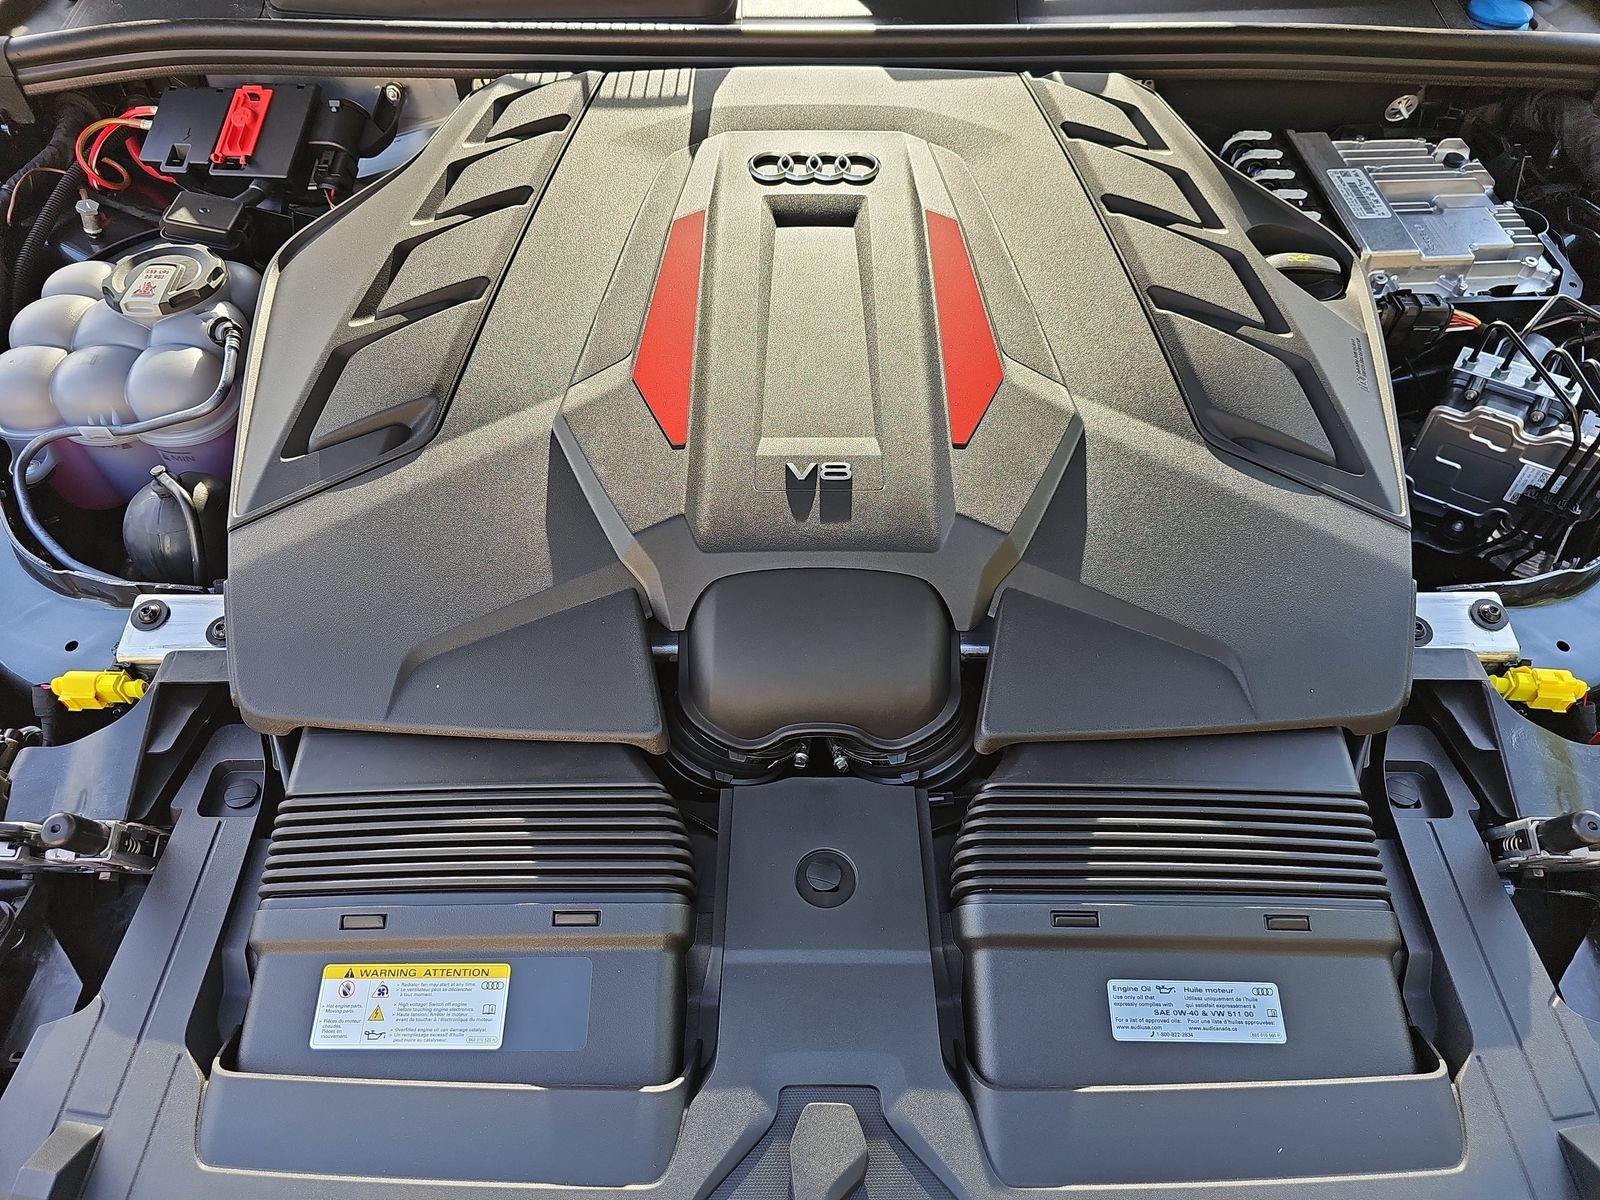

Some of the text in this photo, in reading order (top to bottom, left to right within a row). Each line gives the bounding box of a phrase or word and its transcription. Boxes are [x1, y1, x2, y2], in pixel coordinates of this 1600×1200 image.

[786, 462, 852, 480] V8
[360, 968, 490, 977] WARNING ATTENTION
